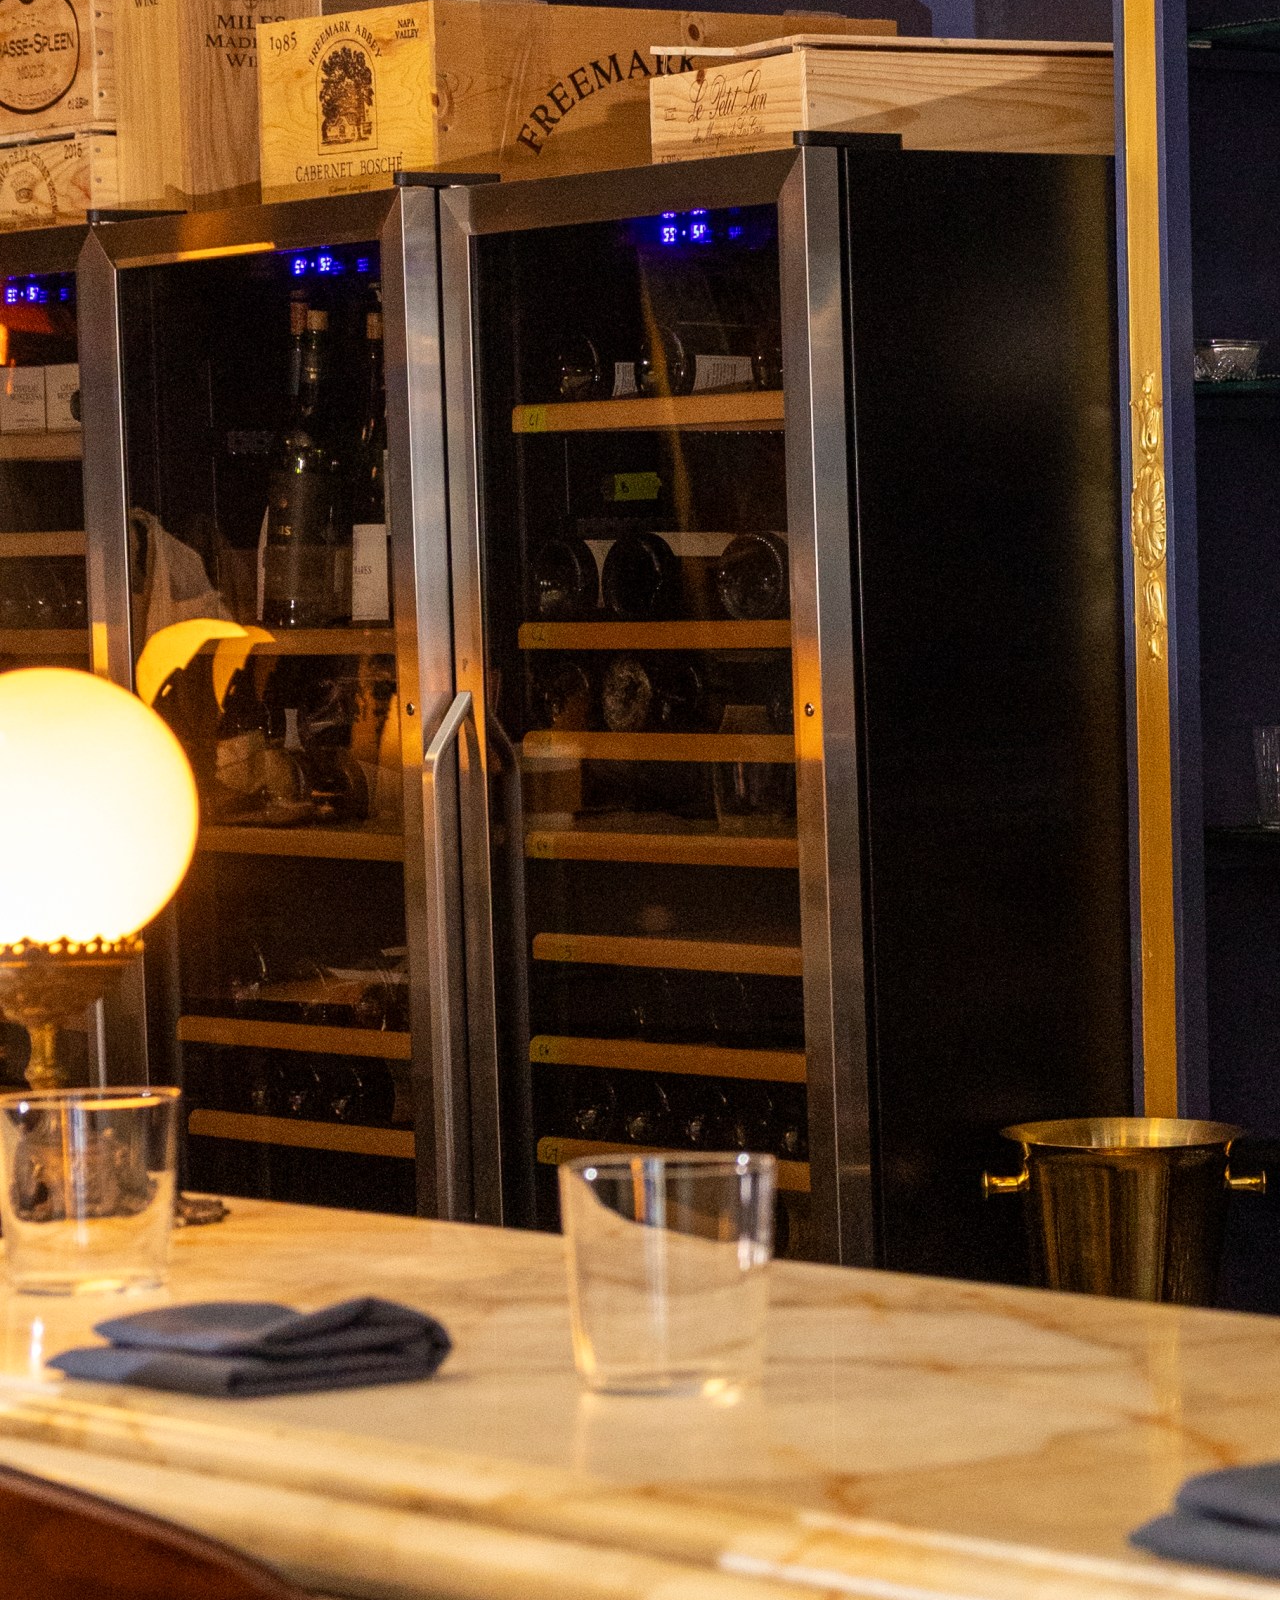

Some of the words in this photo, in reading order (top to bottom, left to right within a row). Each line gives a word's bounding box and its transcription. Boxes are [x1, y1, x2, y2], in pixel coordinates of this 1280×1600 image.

[394, 28, 420, 40] VALLEY
[397, 18, 416, 29] NAPA
[269, 31, 298, 57] 1985
[355, 24, 383, 58] ABBEY
[295, 160, 354, 184] CABERNET
